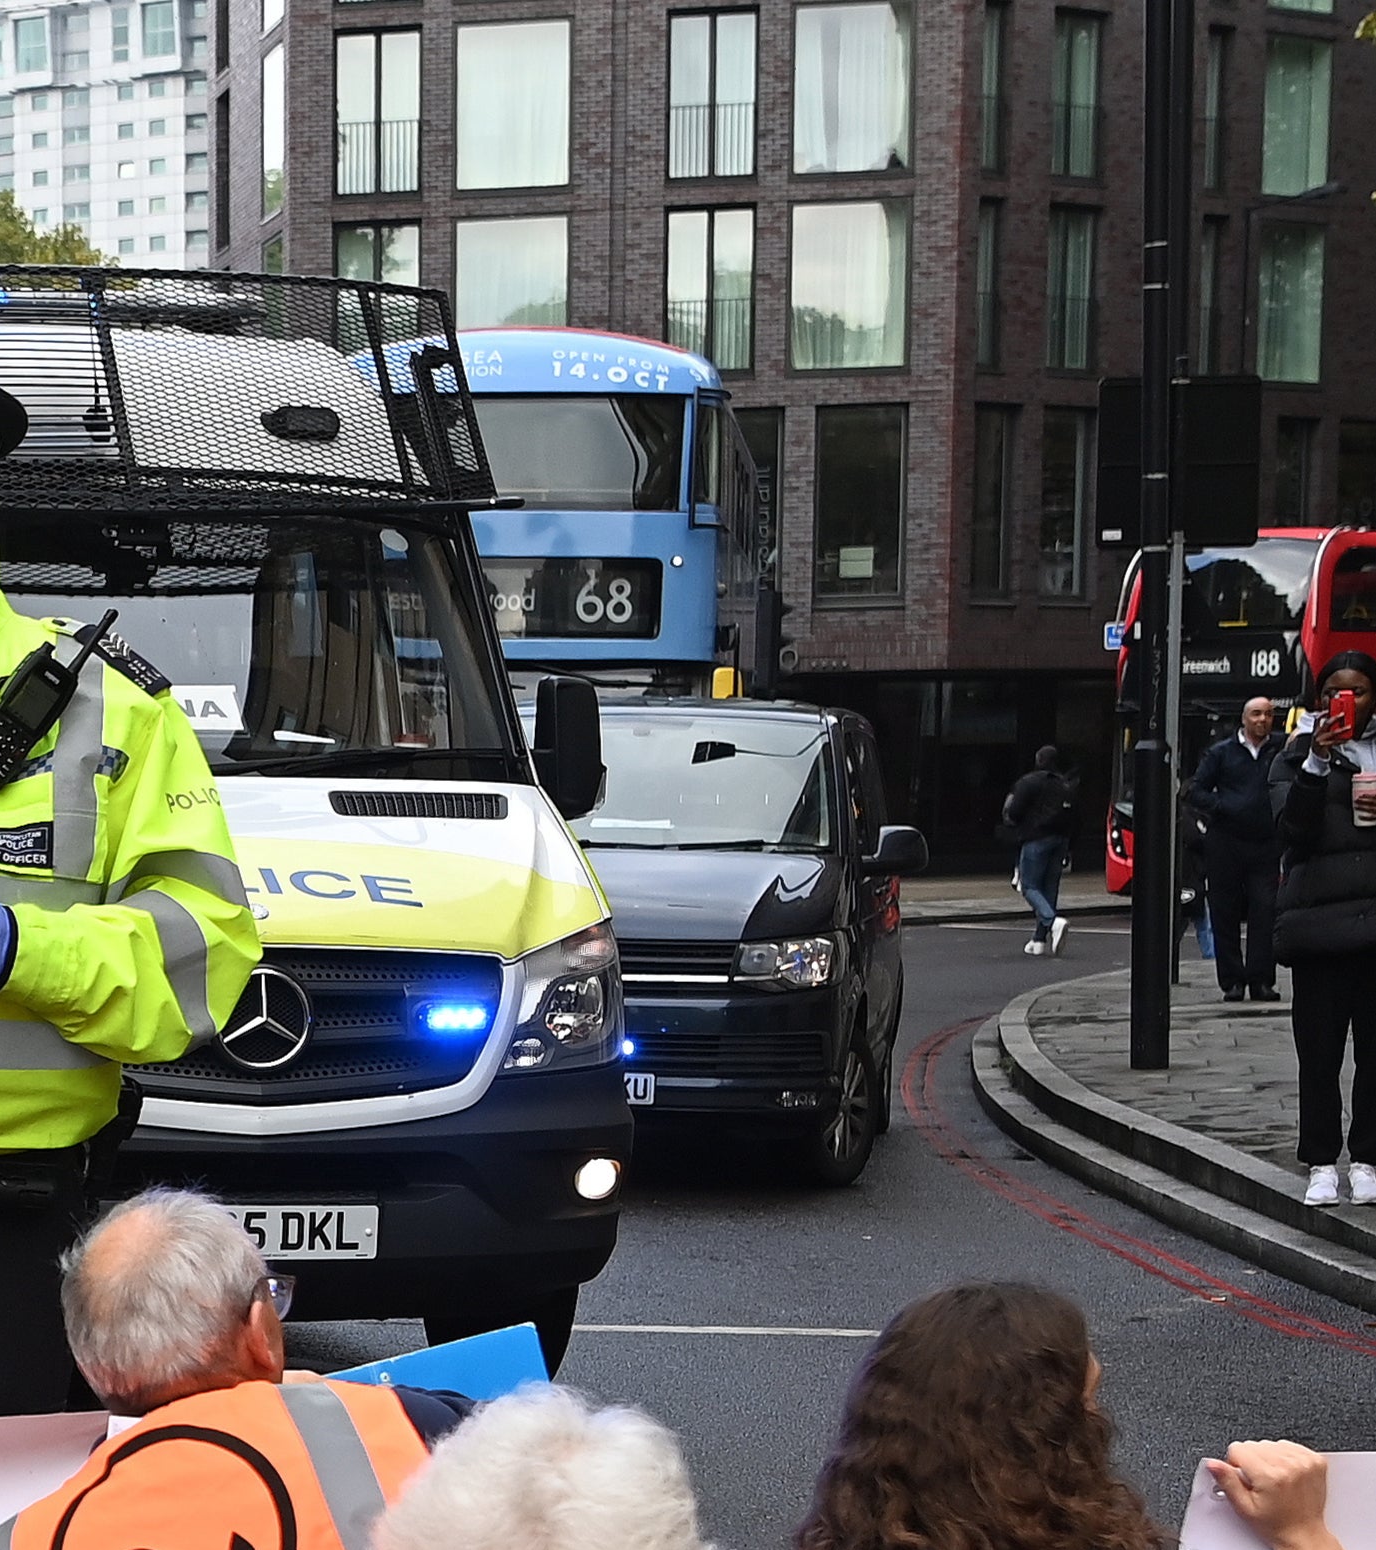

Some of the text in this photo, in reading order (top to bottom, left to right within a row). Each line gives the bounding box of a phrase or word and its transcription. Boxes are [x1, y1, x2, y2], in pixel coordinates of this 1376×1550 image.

[552, 349, 606, 364] OPEN
[551, 360, 670, 392] 14.OCT
[575, 577, 634, 624] 68
[1251, 648, 1281, 677] 188
[2, 853, 47, 865] OFFICER
[280, 1211, 360, 1251] DKL
